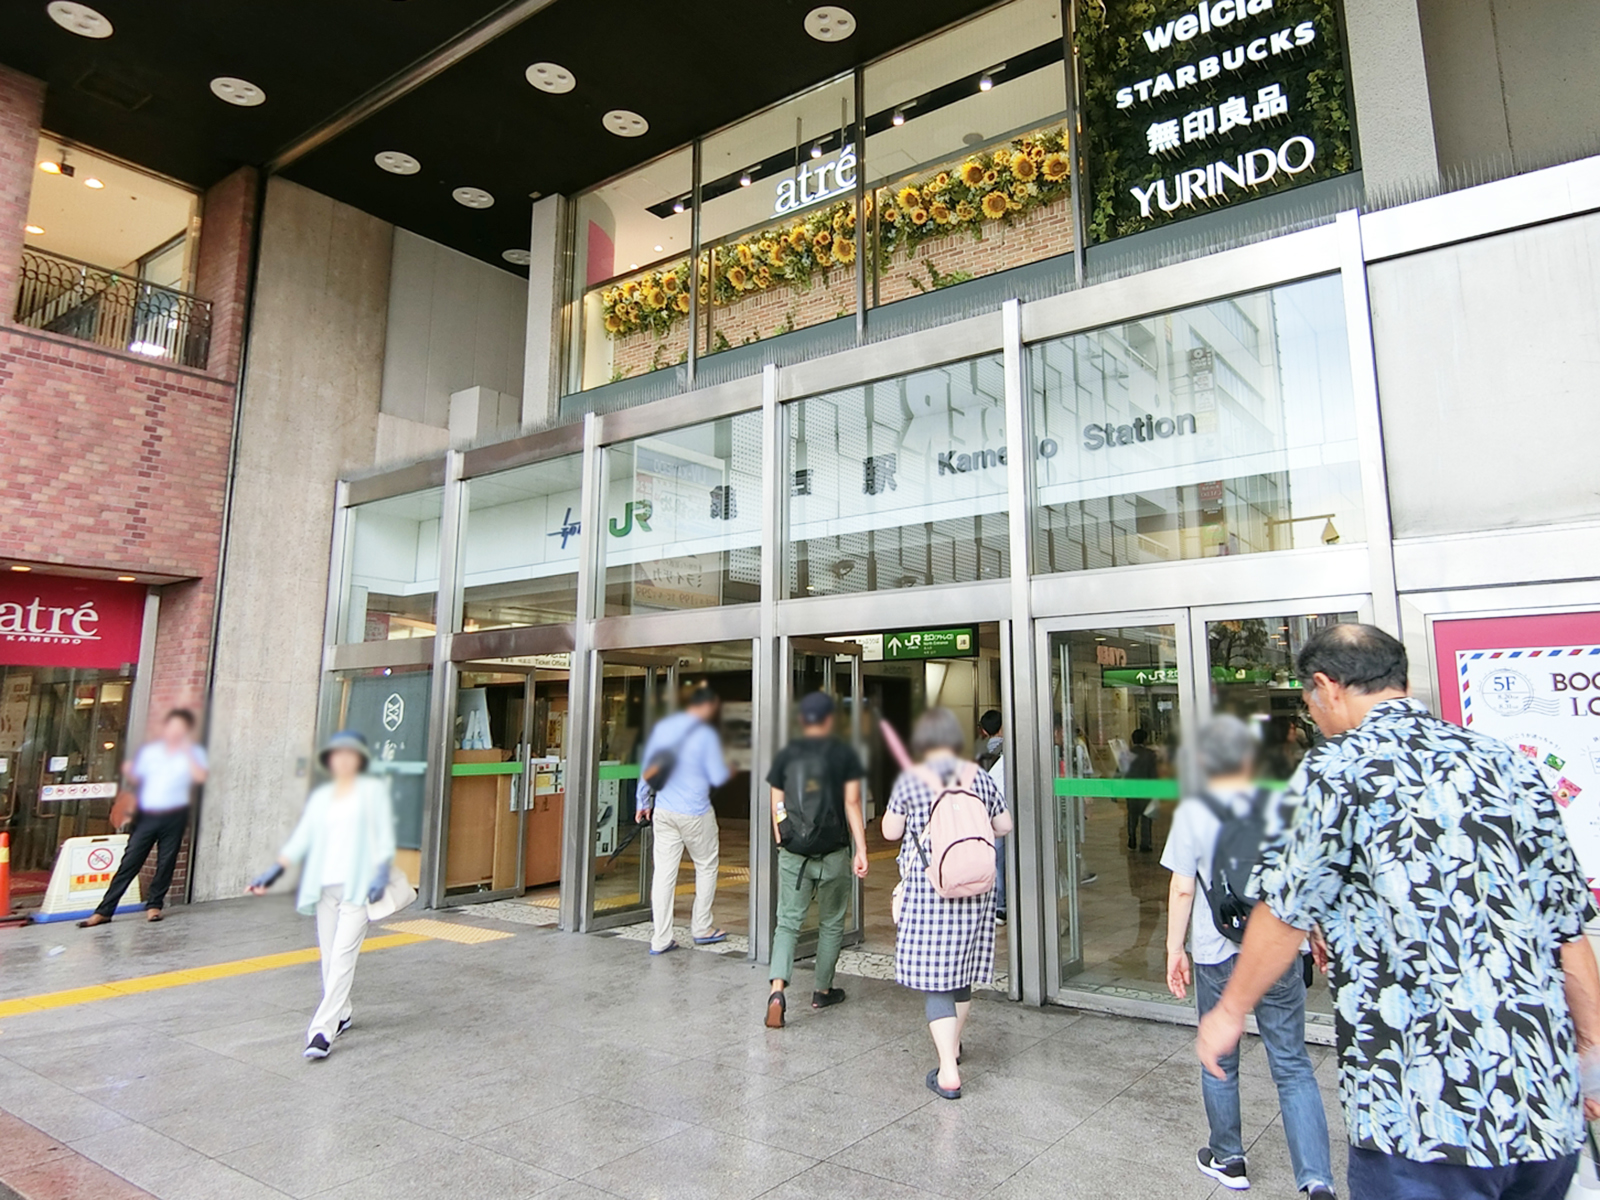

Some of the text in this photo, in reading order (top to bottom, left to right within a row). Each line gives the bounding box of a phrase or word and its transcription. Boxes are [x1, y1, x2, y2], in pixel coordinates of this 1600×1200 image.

[1116, 21, 1316, 109] STARBUCKS
[1146, 83, 1288, 155] 無印良品
[774, 144, 857, 213] atré
[1130, 135, 1315, 217] YURINDO
[609, 500, 653, 538] JR
[1083, 413, 1197, 450] Station
[0, 597, 99, 637] atré
[6, 635, 82, 645] KAMEIDO
[904, 634, 921, 646] JR
[1493, 676, 1517, 691] 5F
